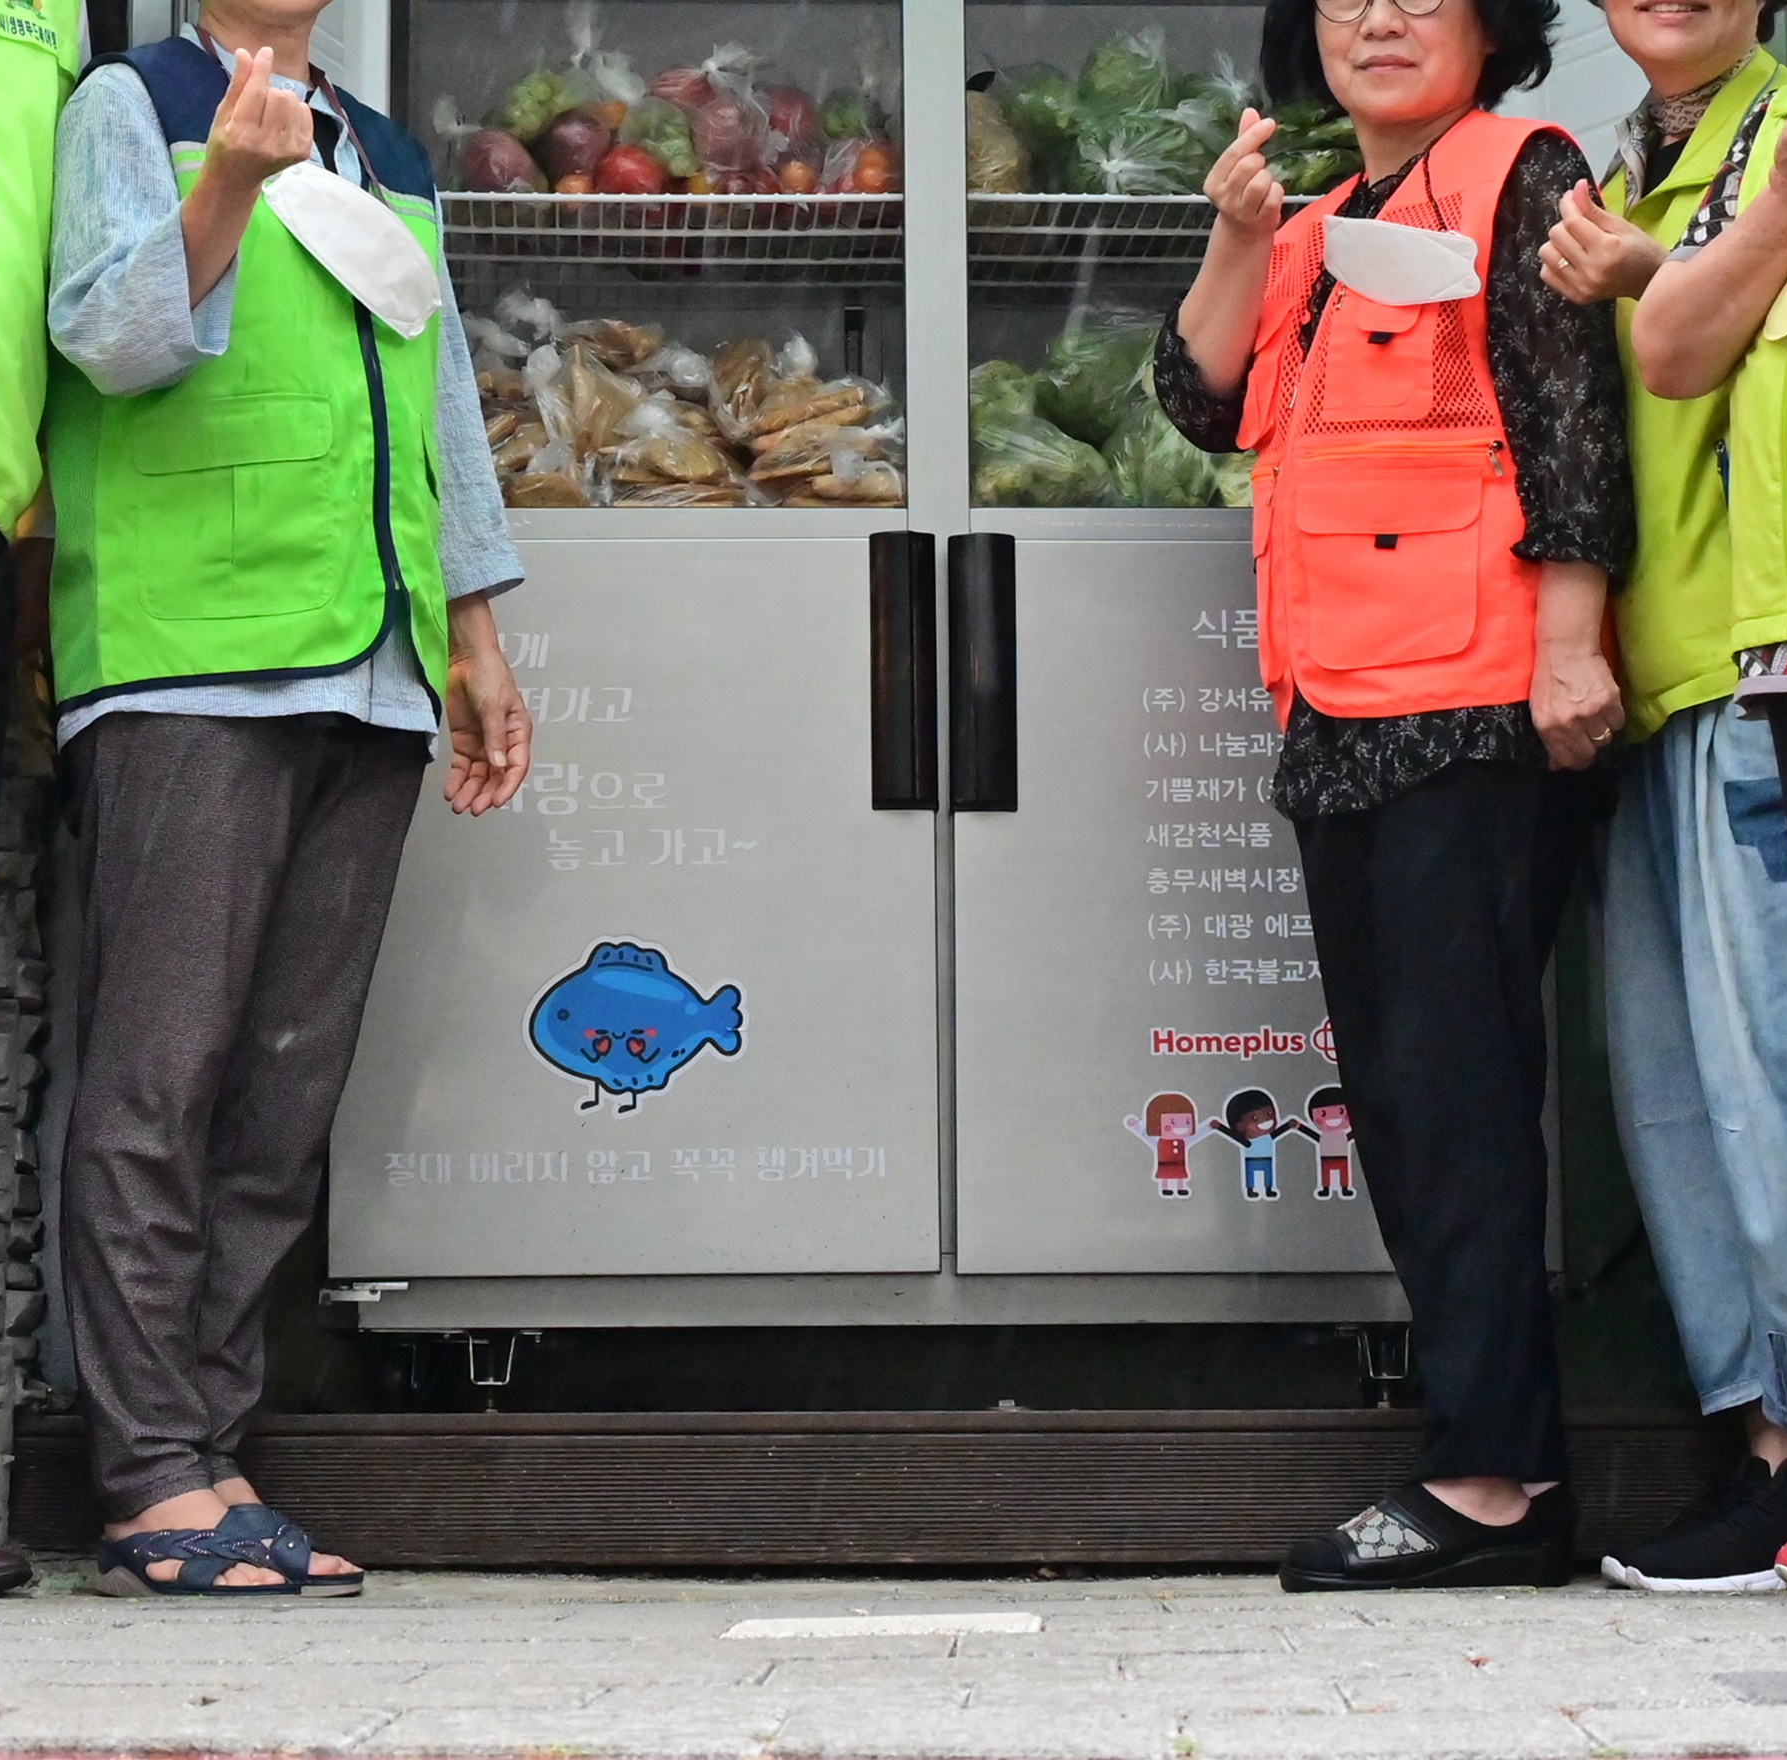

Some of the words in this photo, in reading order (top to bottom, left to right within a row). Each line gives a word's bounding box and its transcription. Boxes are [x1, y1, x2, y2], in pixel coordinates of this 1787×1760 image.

[1142, 687, 1186, 714] (주)
[1198, 687, 1273, 713] 강서유
[1143, 732, 1186, 759] (사)
[1145, 777, 1246, 803] 기쁨재가
[1145, 822, 1272, 849] 새감천식품
[546, 829, 627, 871] 놓고
[1146, 867, 1300, 894] 충무새벽시장
[1147, 913, 1191, 940] (주)
[1204, 913, 1254, 940] 대광
[1148, 959, 1192, 986] (사)
[1151, 1026, 1305, 1060] Homeplus
[384, 1151, 452, 1187] 절대
[469, 1150, 568, 1184] 버리지
[587, 1148, 653, 1185] 않고
[669, 1147, 737, 1183] 꼭꼭
[755, 1145, 886, 1183] 챙겨먹기
